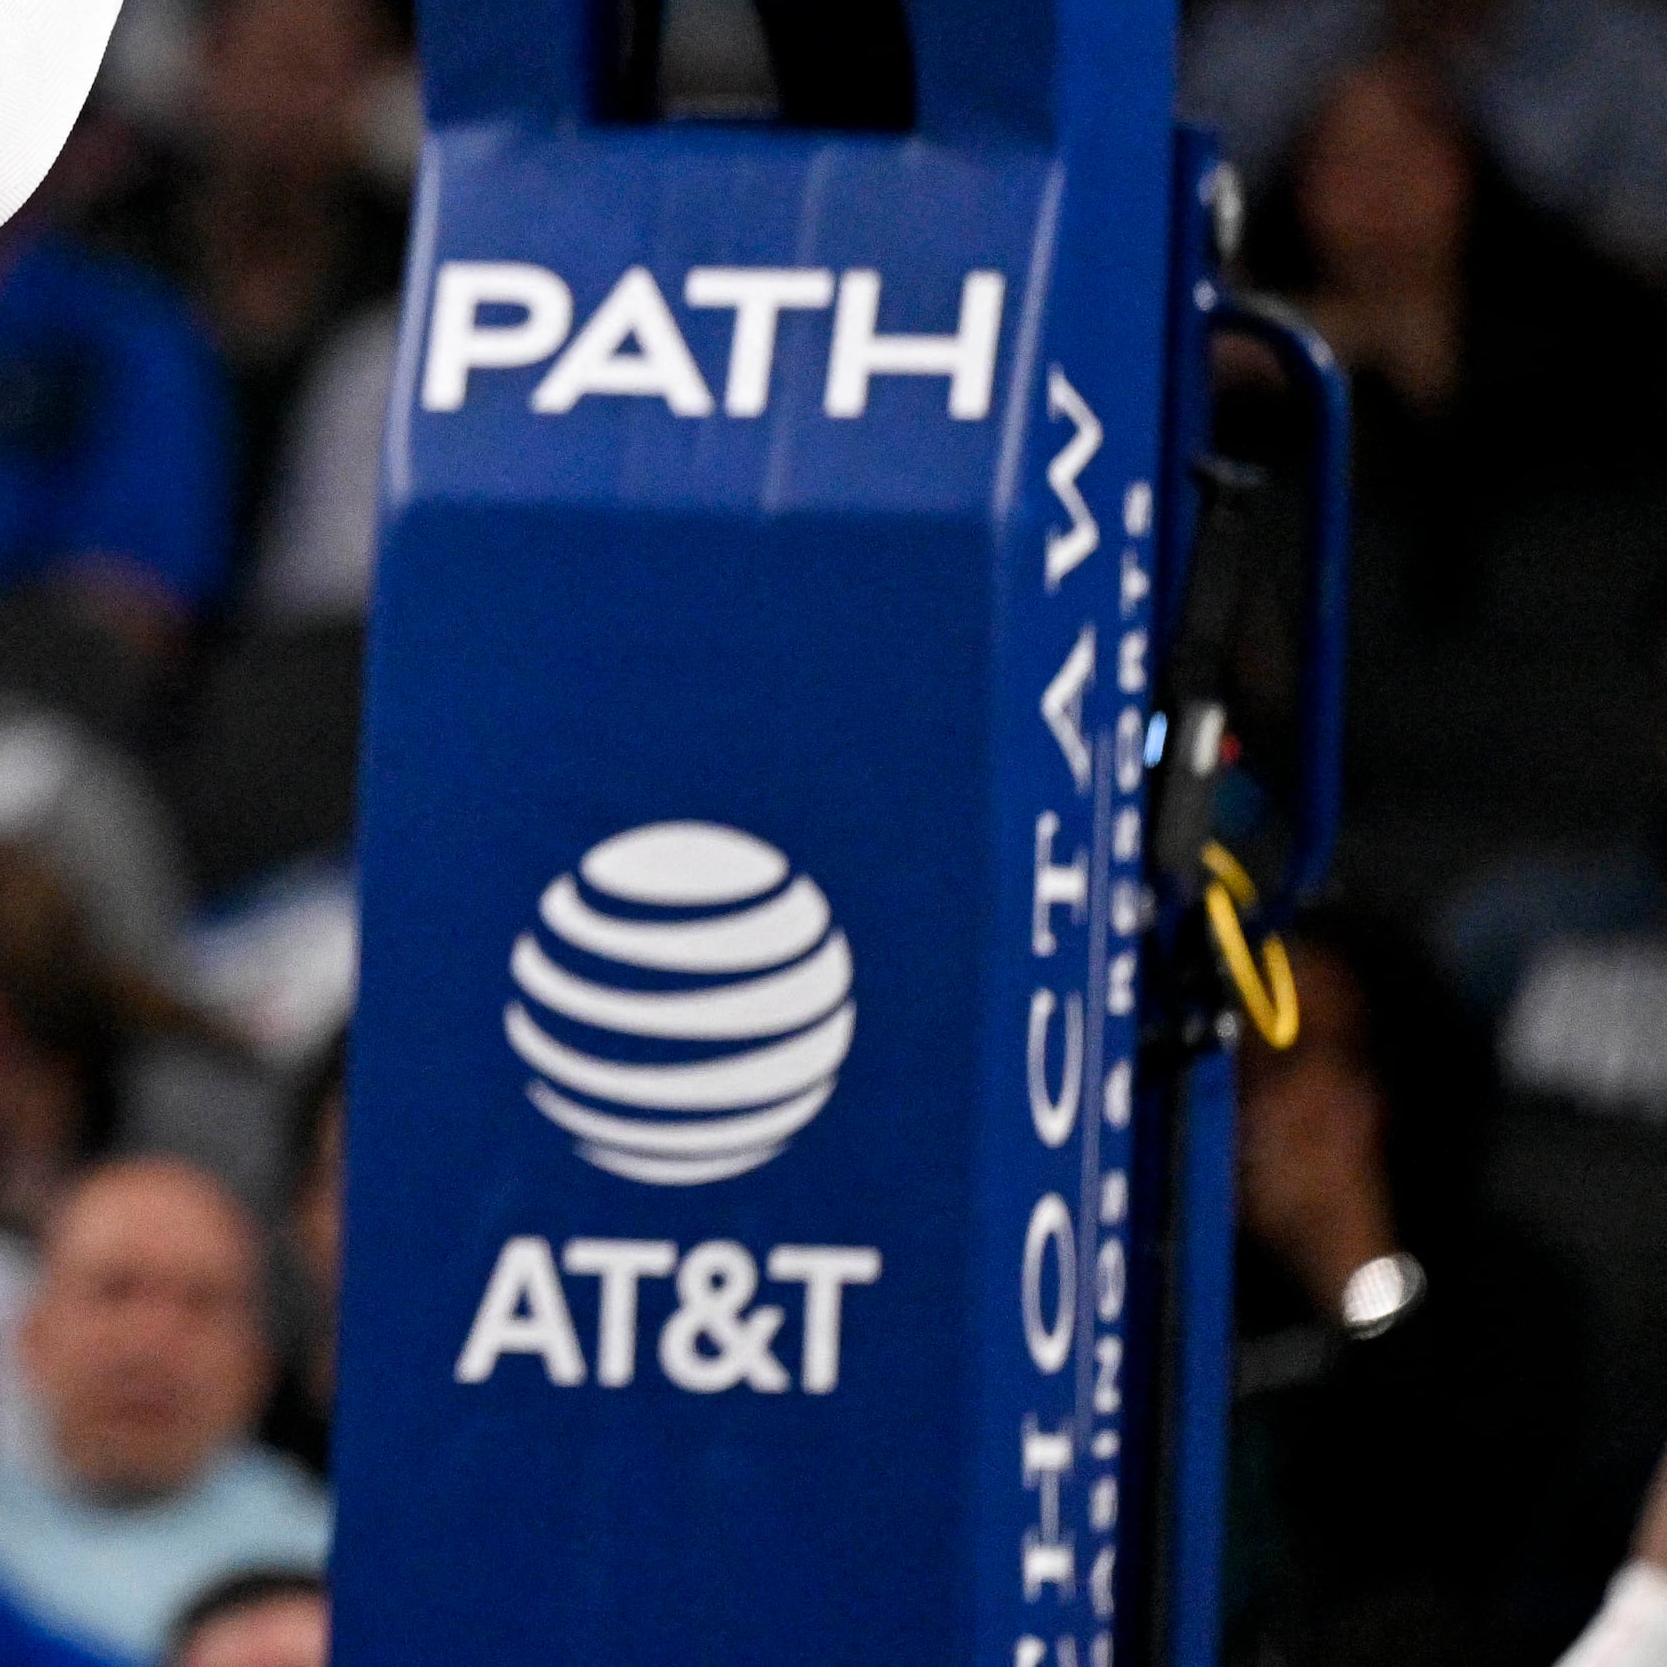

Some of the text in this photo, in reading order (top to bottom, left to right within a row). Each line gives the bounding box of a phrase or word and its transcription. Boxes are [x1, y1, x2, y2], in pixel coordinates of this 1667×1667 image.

[420, 259, 1007, 421] PATH
[1015, 363, 1104, 1667] HOCTAW
[453, 1235, 882, 1395] AT&T
